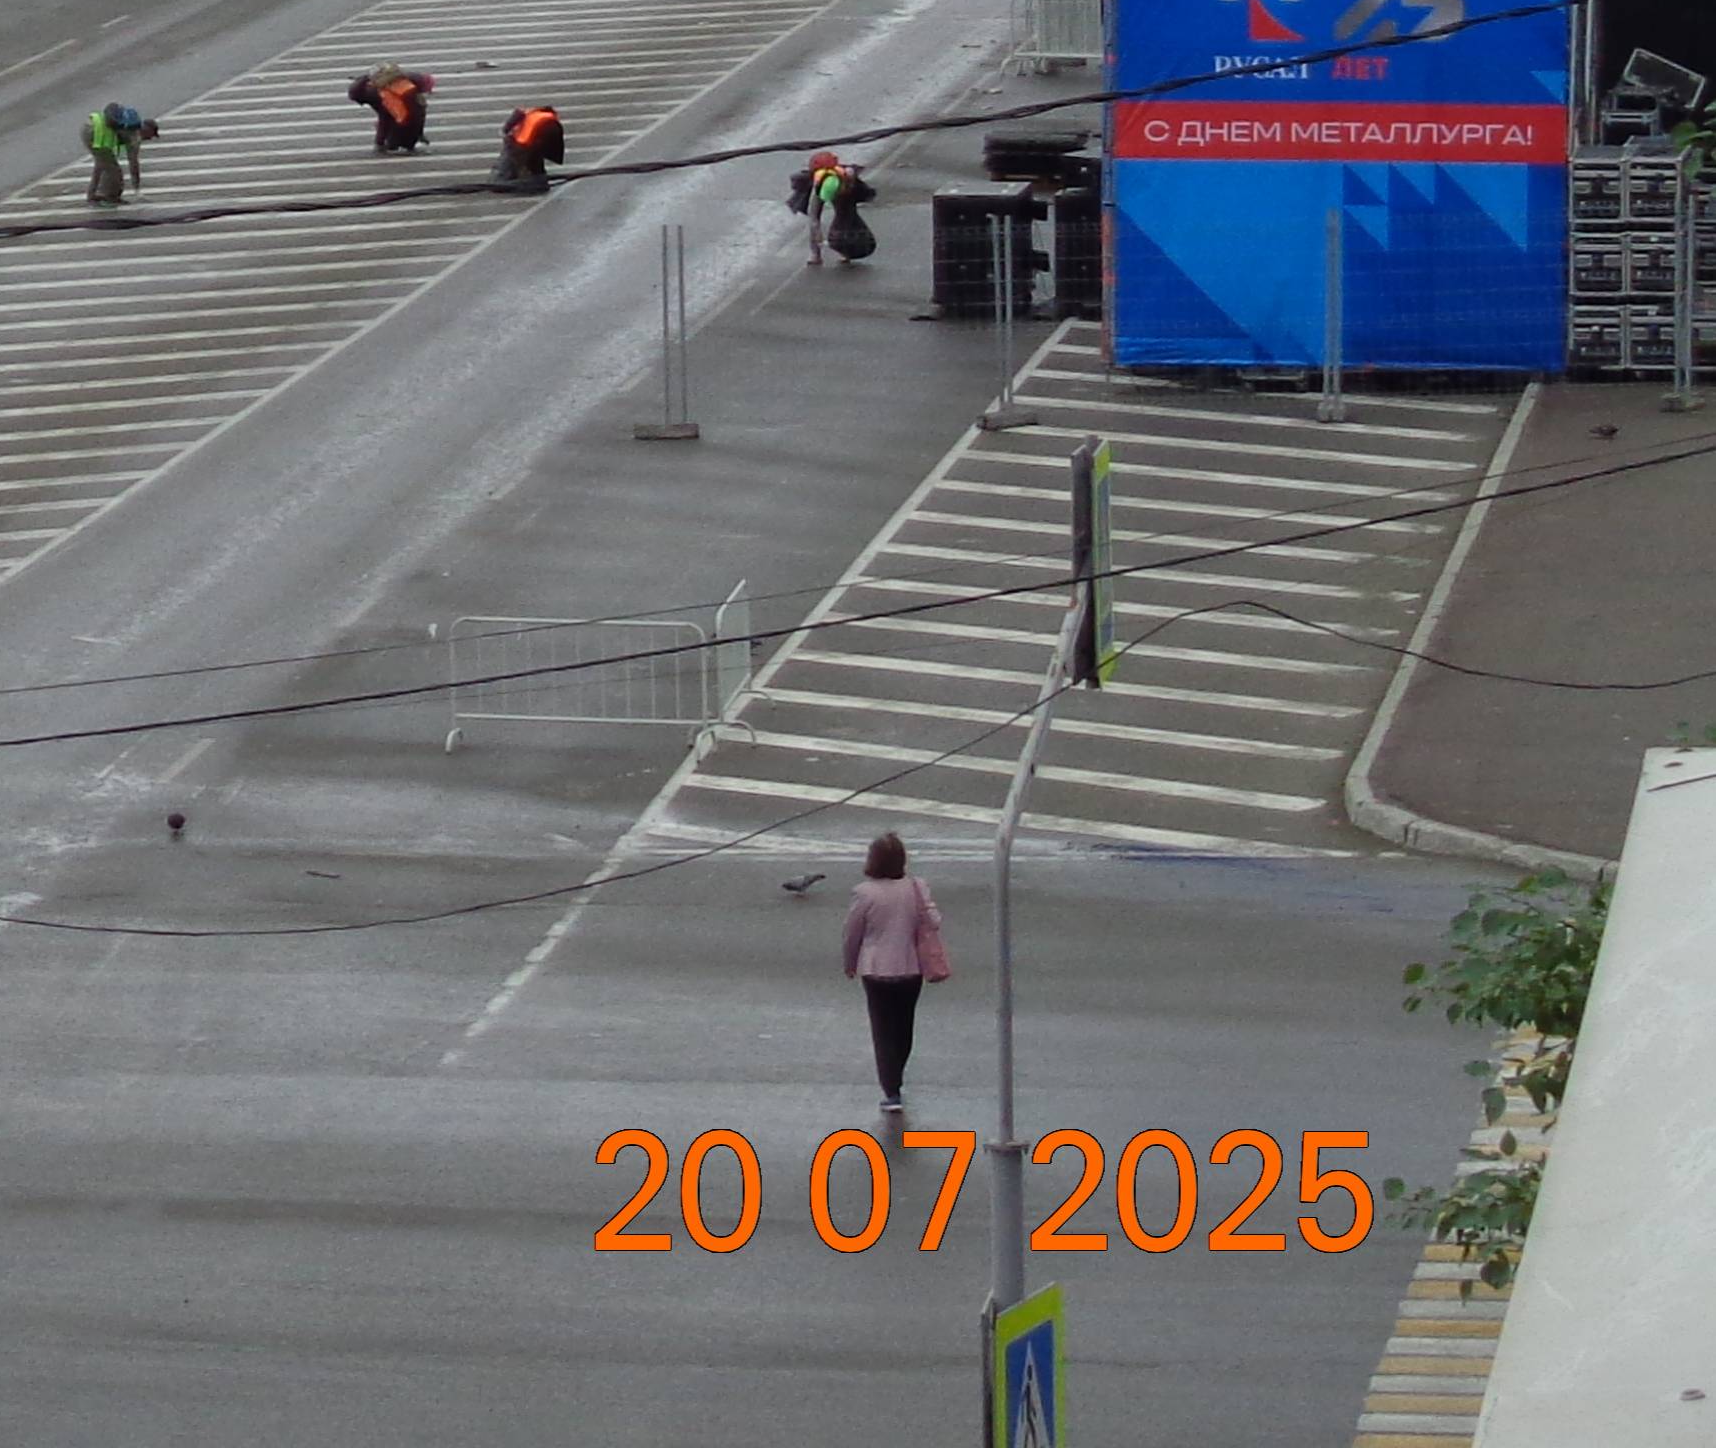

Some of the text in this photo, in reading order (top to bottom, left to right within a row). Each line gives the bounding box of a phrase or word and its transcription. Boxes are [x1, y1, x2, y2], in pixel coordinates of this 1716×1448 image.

[1331, 55, 1390, 81] ЛЕТ
[1143, 119, 1534, 148] С ДНЕМ МЕТАЛЛУРГА!
